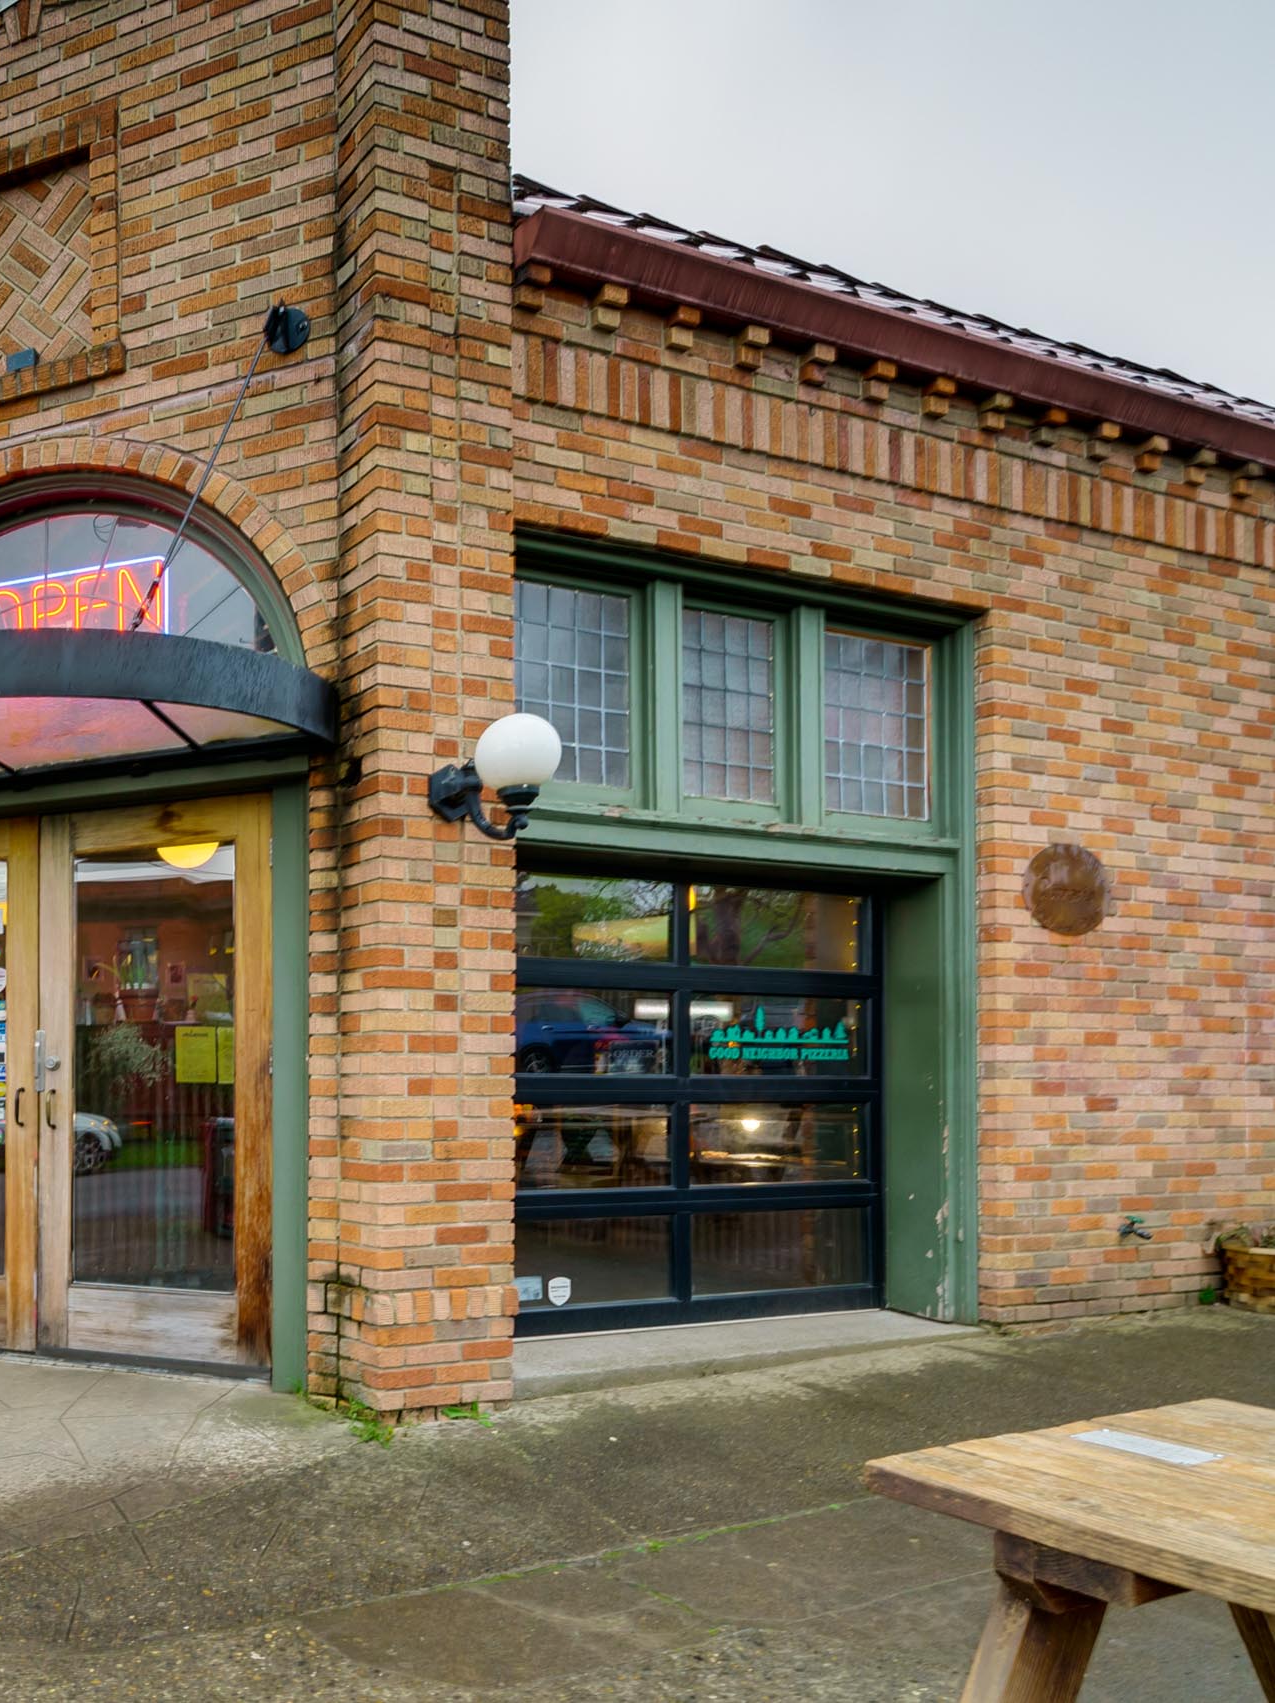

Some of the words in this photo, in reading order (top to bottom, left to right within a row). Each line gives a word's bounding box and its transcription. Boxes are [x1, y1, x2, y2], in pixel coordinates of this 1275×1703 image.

[613, 1049, 654, 1058] ORDER
[709, 1047, 740, 1060] GOOD
[742, 1047, 799, 1060] NEIGHBOR
[800, 1048, 849, 1060] PIZZERIA
